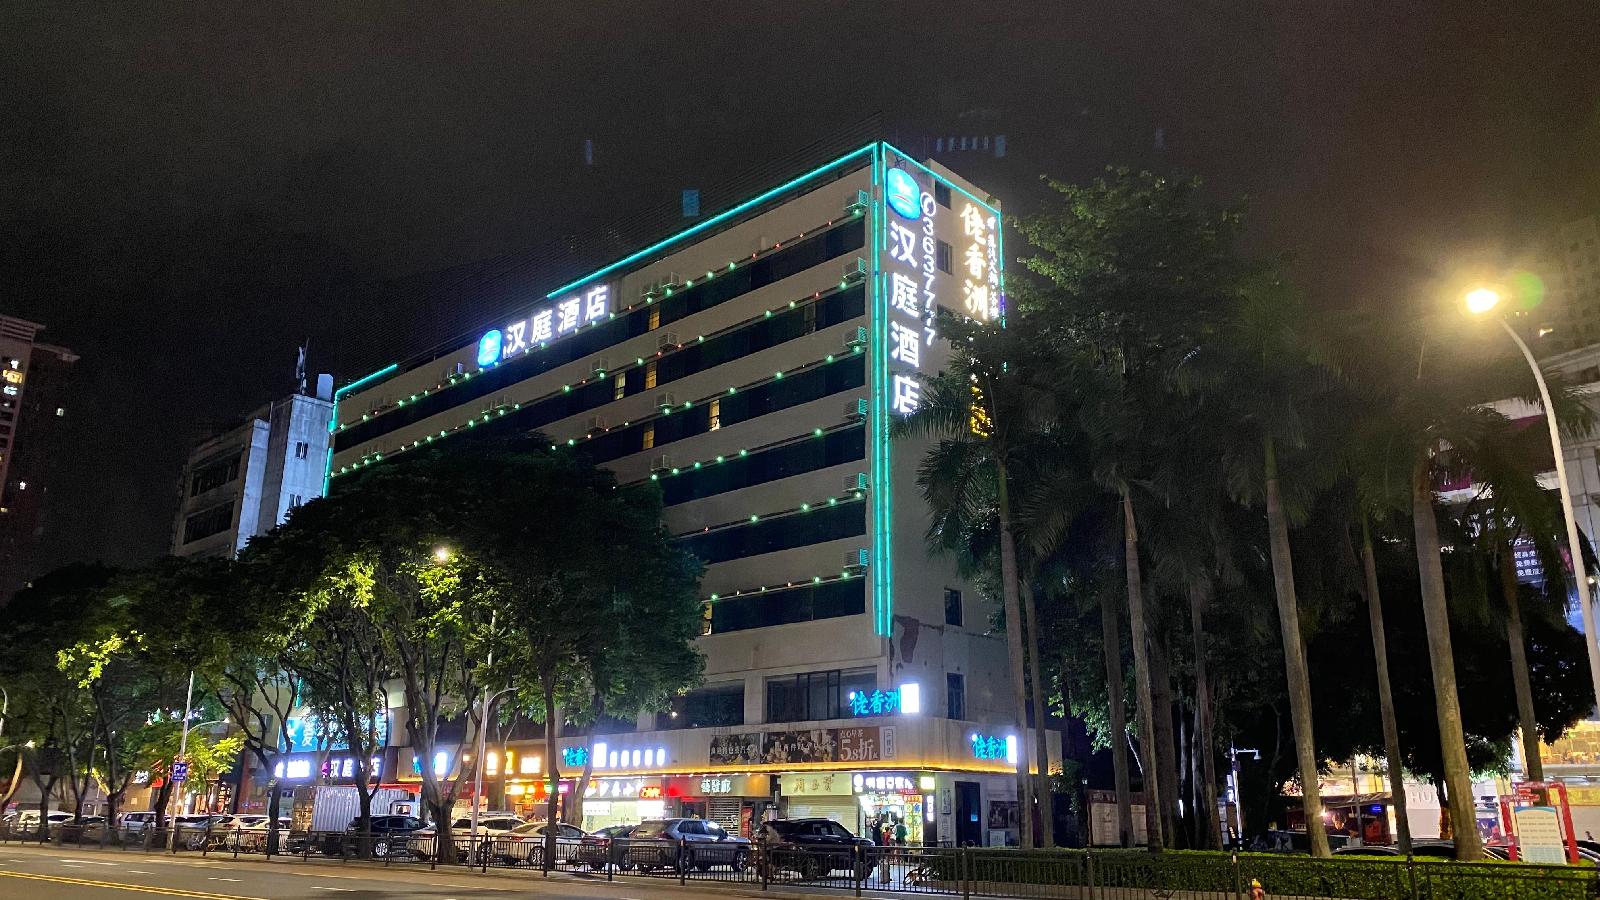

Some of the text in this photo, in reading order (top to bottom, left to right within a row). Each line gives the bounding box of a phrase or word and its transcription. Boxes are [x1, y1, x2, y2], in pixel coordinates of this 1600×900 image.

[503, 285, 608, 358] 汉庭酒店
[890, 221, 920, 413] 汉庭酒店
[330, 758, 381, 778] 汉庭店
